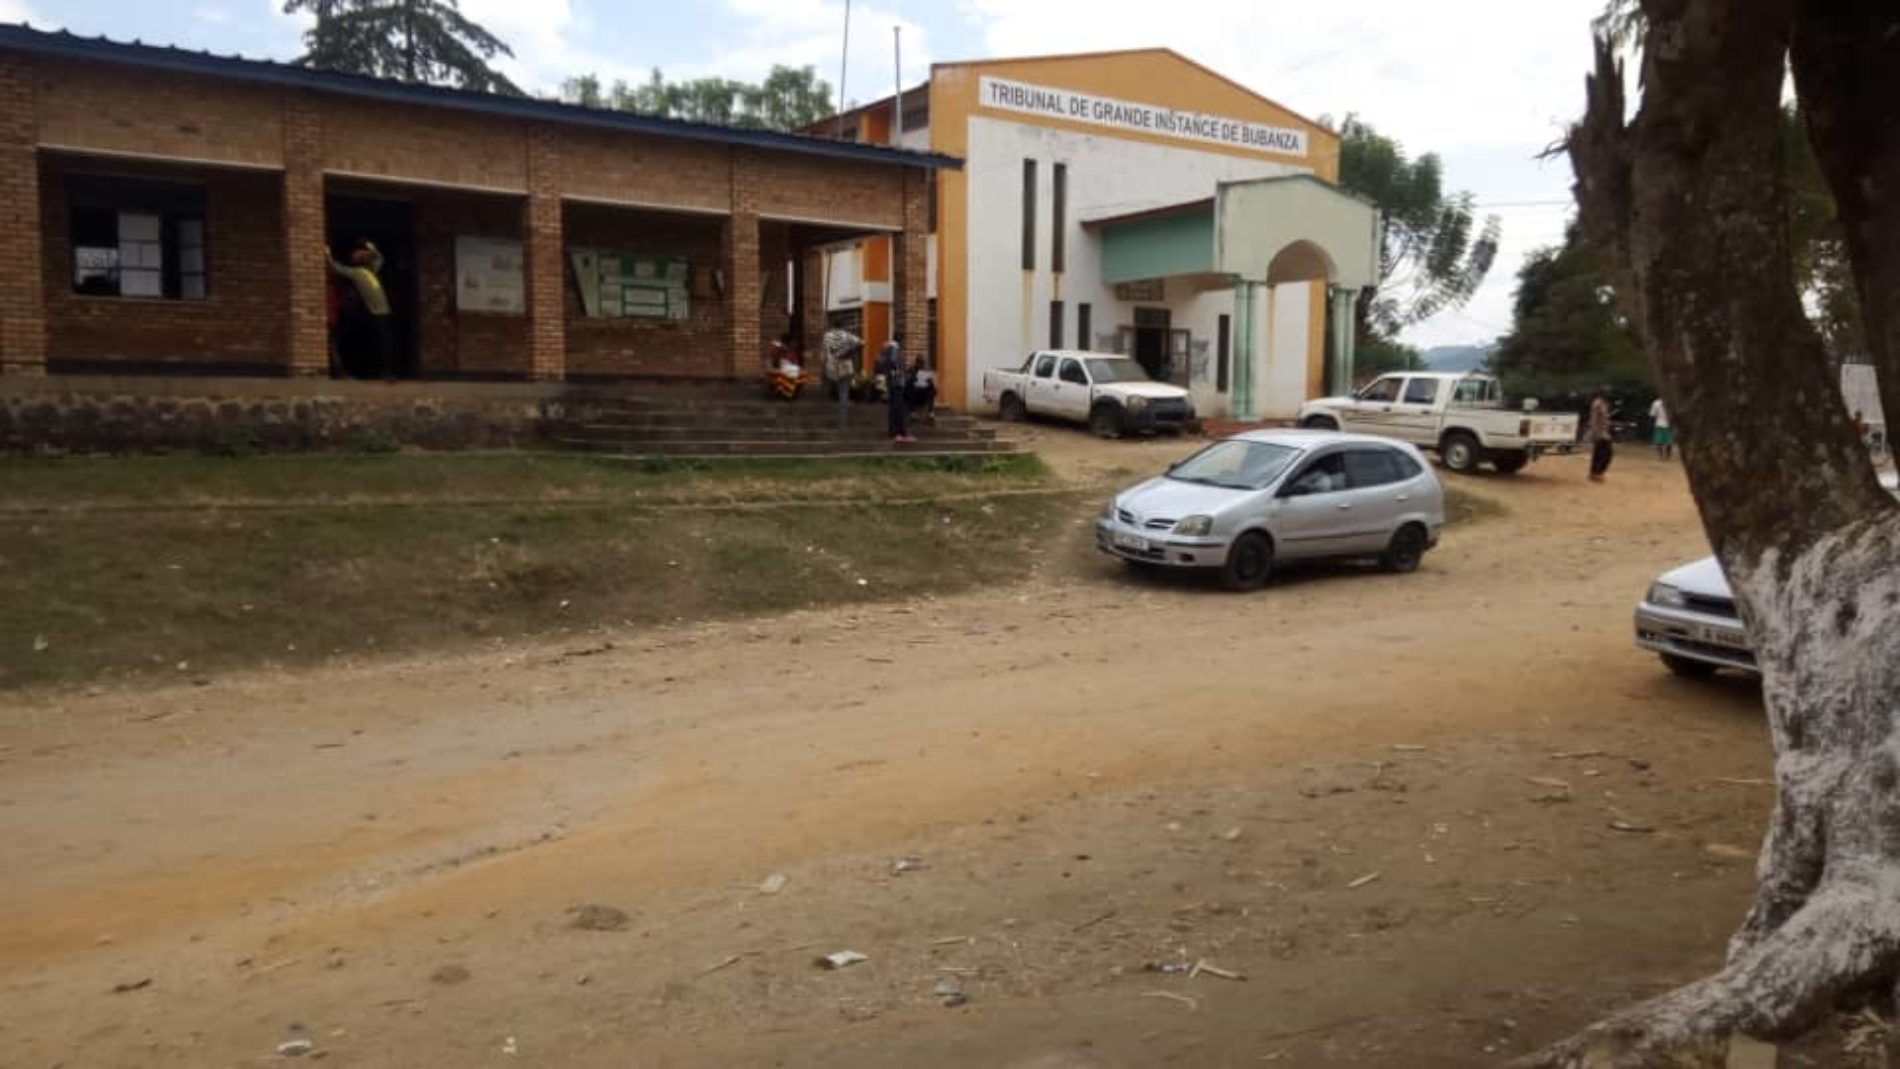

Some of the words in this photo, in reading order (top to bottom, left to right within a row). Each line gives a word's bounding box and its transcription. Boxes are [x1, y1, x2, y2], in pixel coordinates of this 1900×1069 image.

[990, 82, 1064, 113] TRIBUNAL
[1070, 96, 1089, 117] DE
[1093, 101, 1151, 127] GRANDE
[1155, 111, 1219, 138] INSTANCE
[1222, 123, 1239, 141] DE
[1242, 126, 1299, 149] BUBANZA
